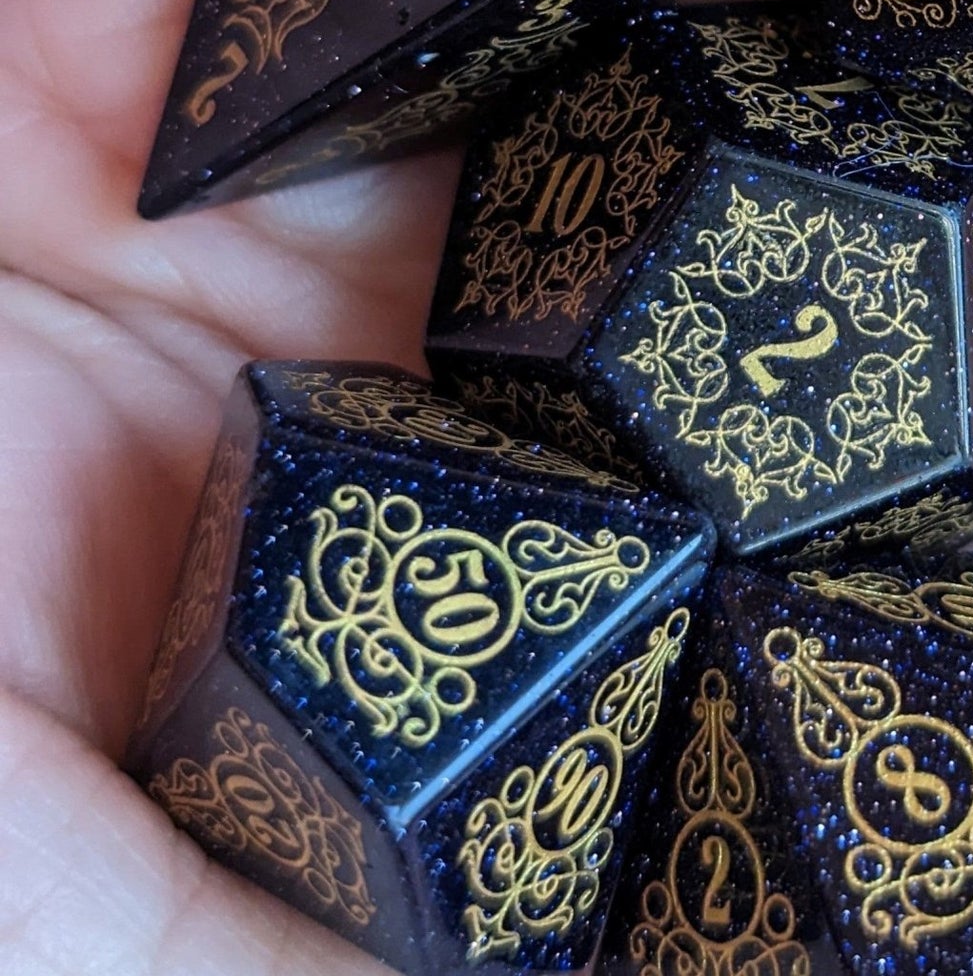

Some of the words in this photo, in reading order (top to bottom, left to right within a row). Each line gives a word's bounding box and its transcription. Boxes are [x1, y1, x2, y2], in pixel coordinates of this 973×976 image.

[189, 43, 249, 124] 2
[524, 153, 605, 234] 10
[740, 305, 840, 398] 2
[406, 549, 501, 646] 50
[537, 748, 609, 835] 90
[876, 744, 951, 821] 8
[702, 835, 731, 923] 2
